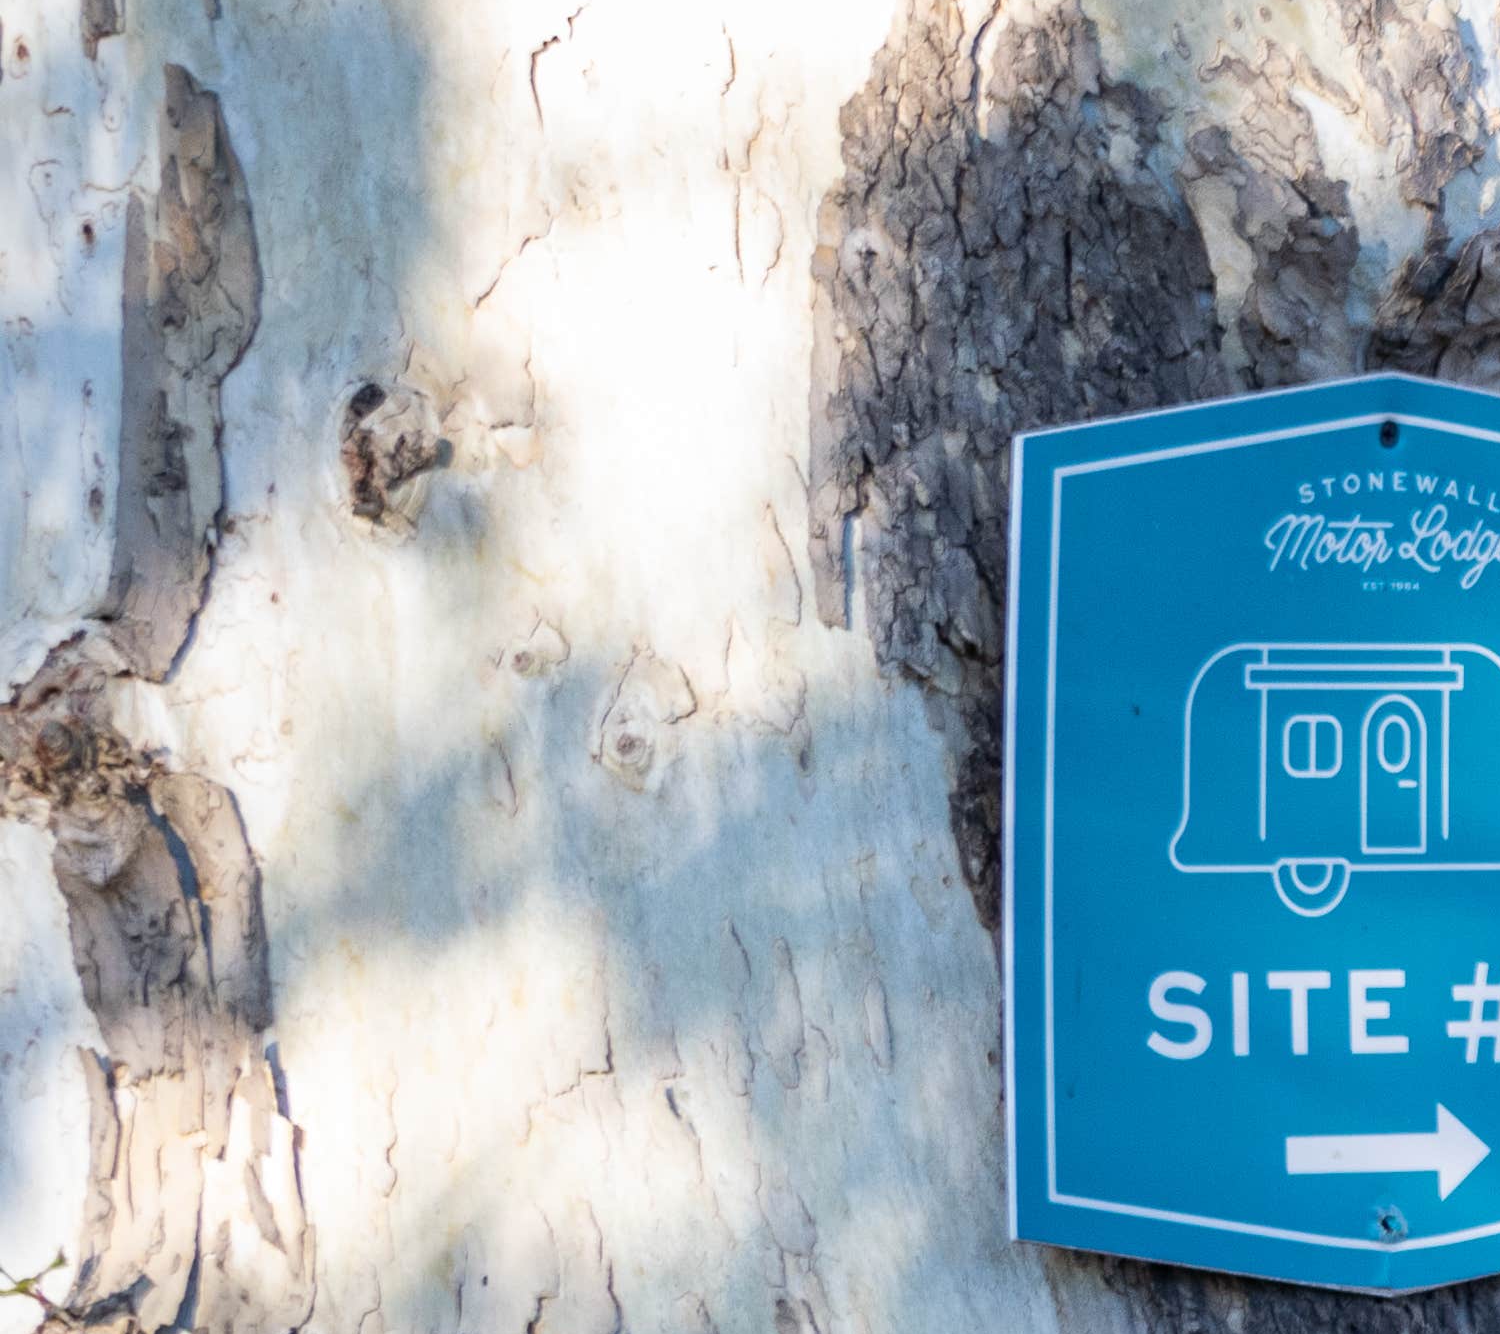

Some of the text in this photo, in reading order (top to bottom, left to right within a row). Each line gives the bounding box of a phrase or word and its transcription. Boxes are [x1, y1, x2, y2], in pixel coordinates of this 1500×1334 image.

[1299, 470, 1500, 513] STONEWALL
[1264, 514, 1394, 571] Motor
[1363, 581, 1385, 591] EST
[1146, 969, 1410, 1060] SITE
